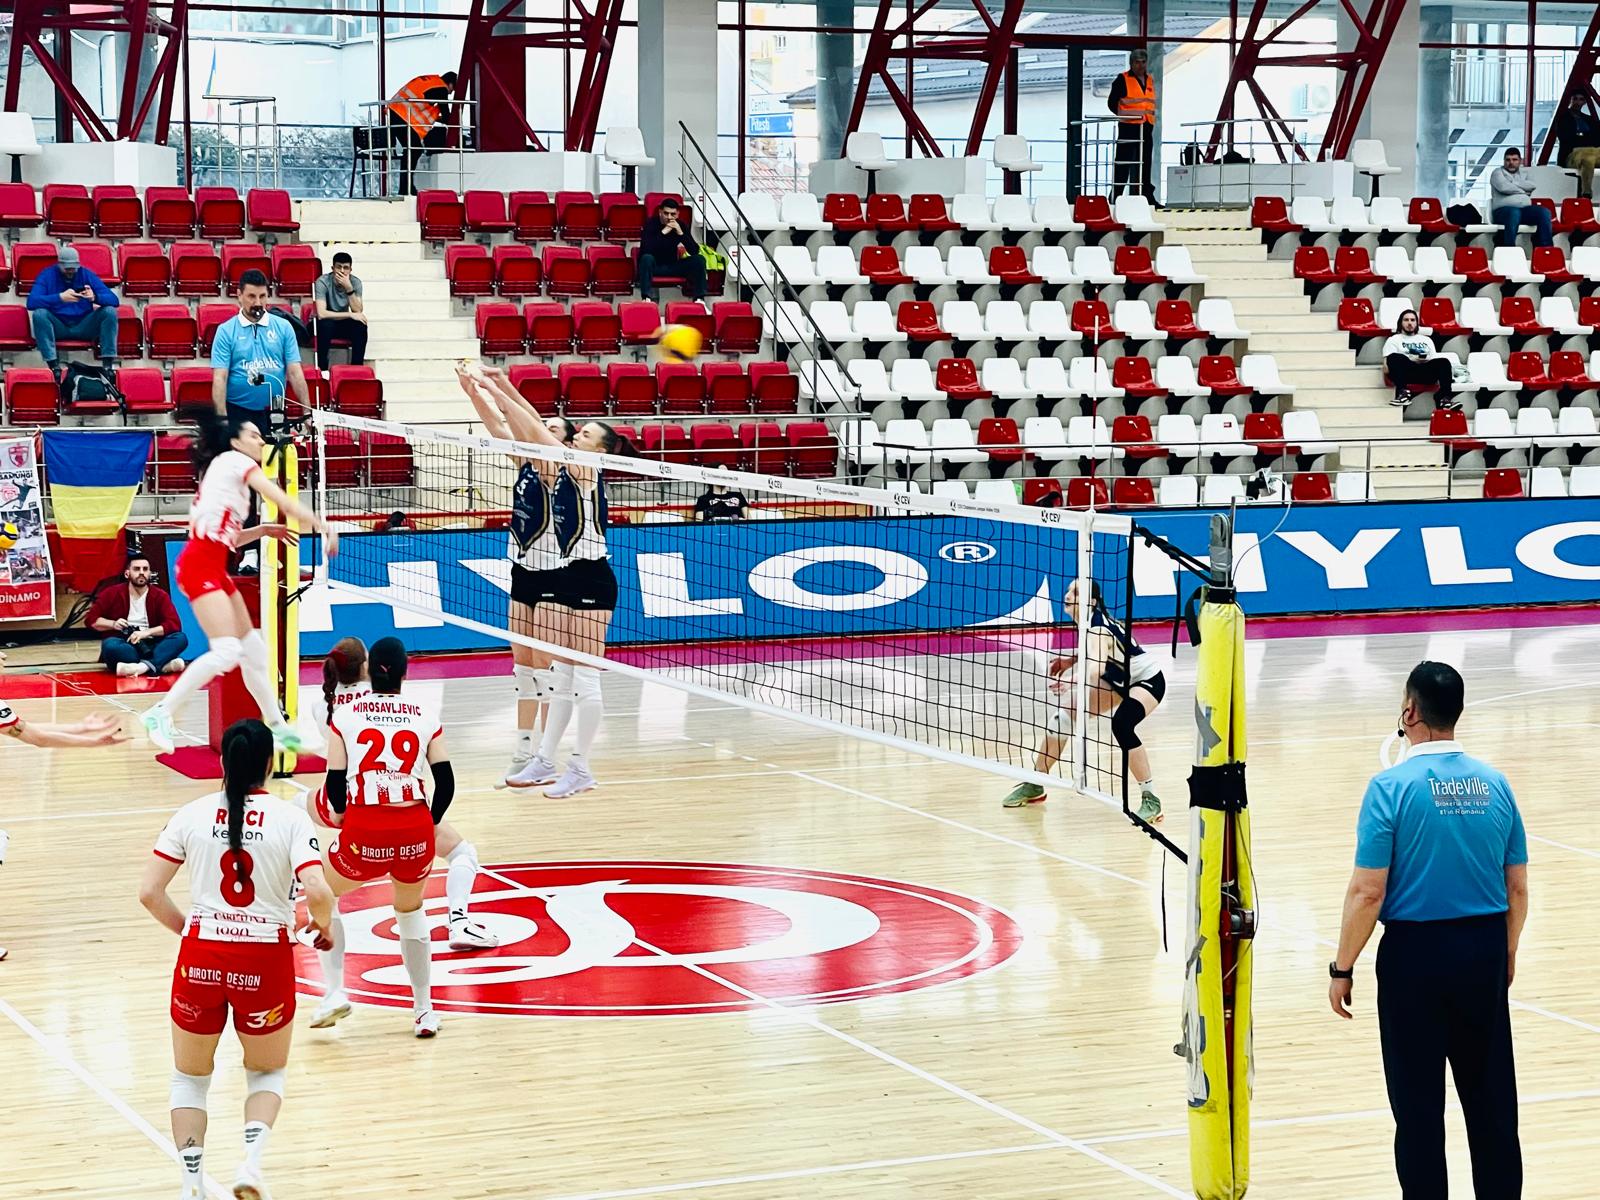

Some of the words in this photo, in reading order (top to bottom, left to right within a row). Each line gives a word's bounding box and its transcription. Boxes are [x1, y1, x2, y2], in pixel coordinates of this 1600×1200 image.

[900, 494, 911, 506] CEV
[1049, 512, 1061, 524] CEV
[366, 713, 411, 724] kemon
[356, 728, 420, 775] 29
[1427, 776, 1490, 796] TradeVille
[215, 808, 265, 828] RCI
[212, 825, 264, 842] keon
[361, 845, 395, 858] BIROTIC
[399, 841, 427, 857] DESIGN
[219, 848, 256, 908] 8
[188, 966, 222, 982] BIROTIC
[226, 971, 261, 987] DESIGN
